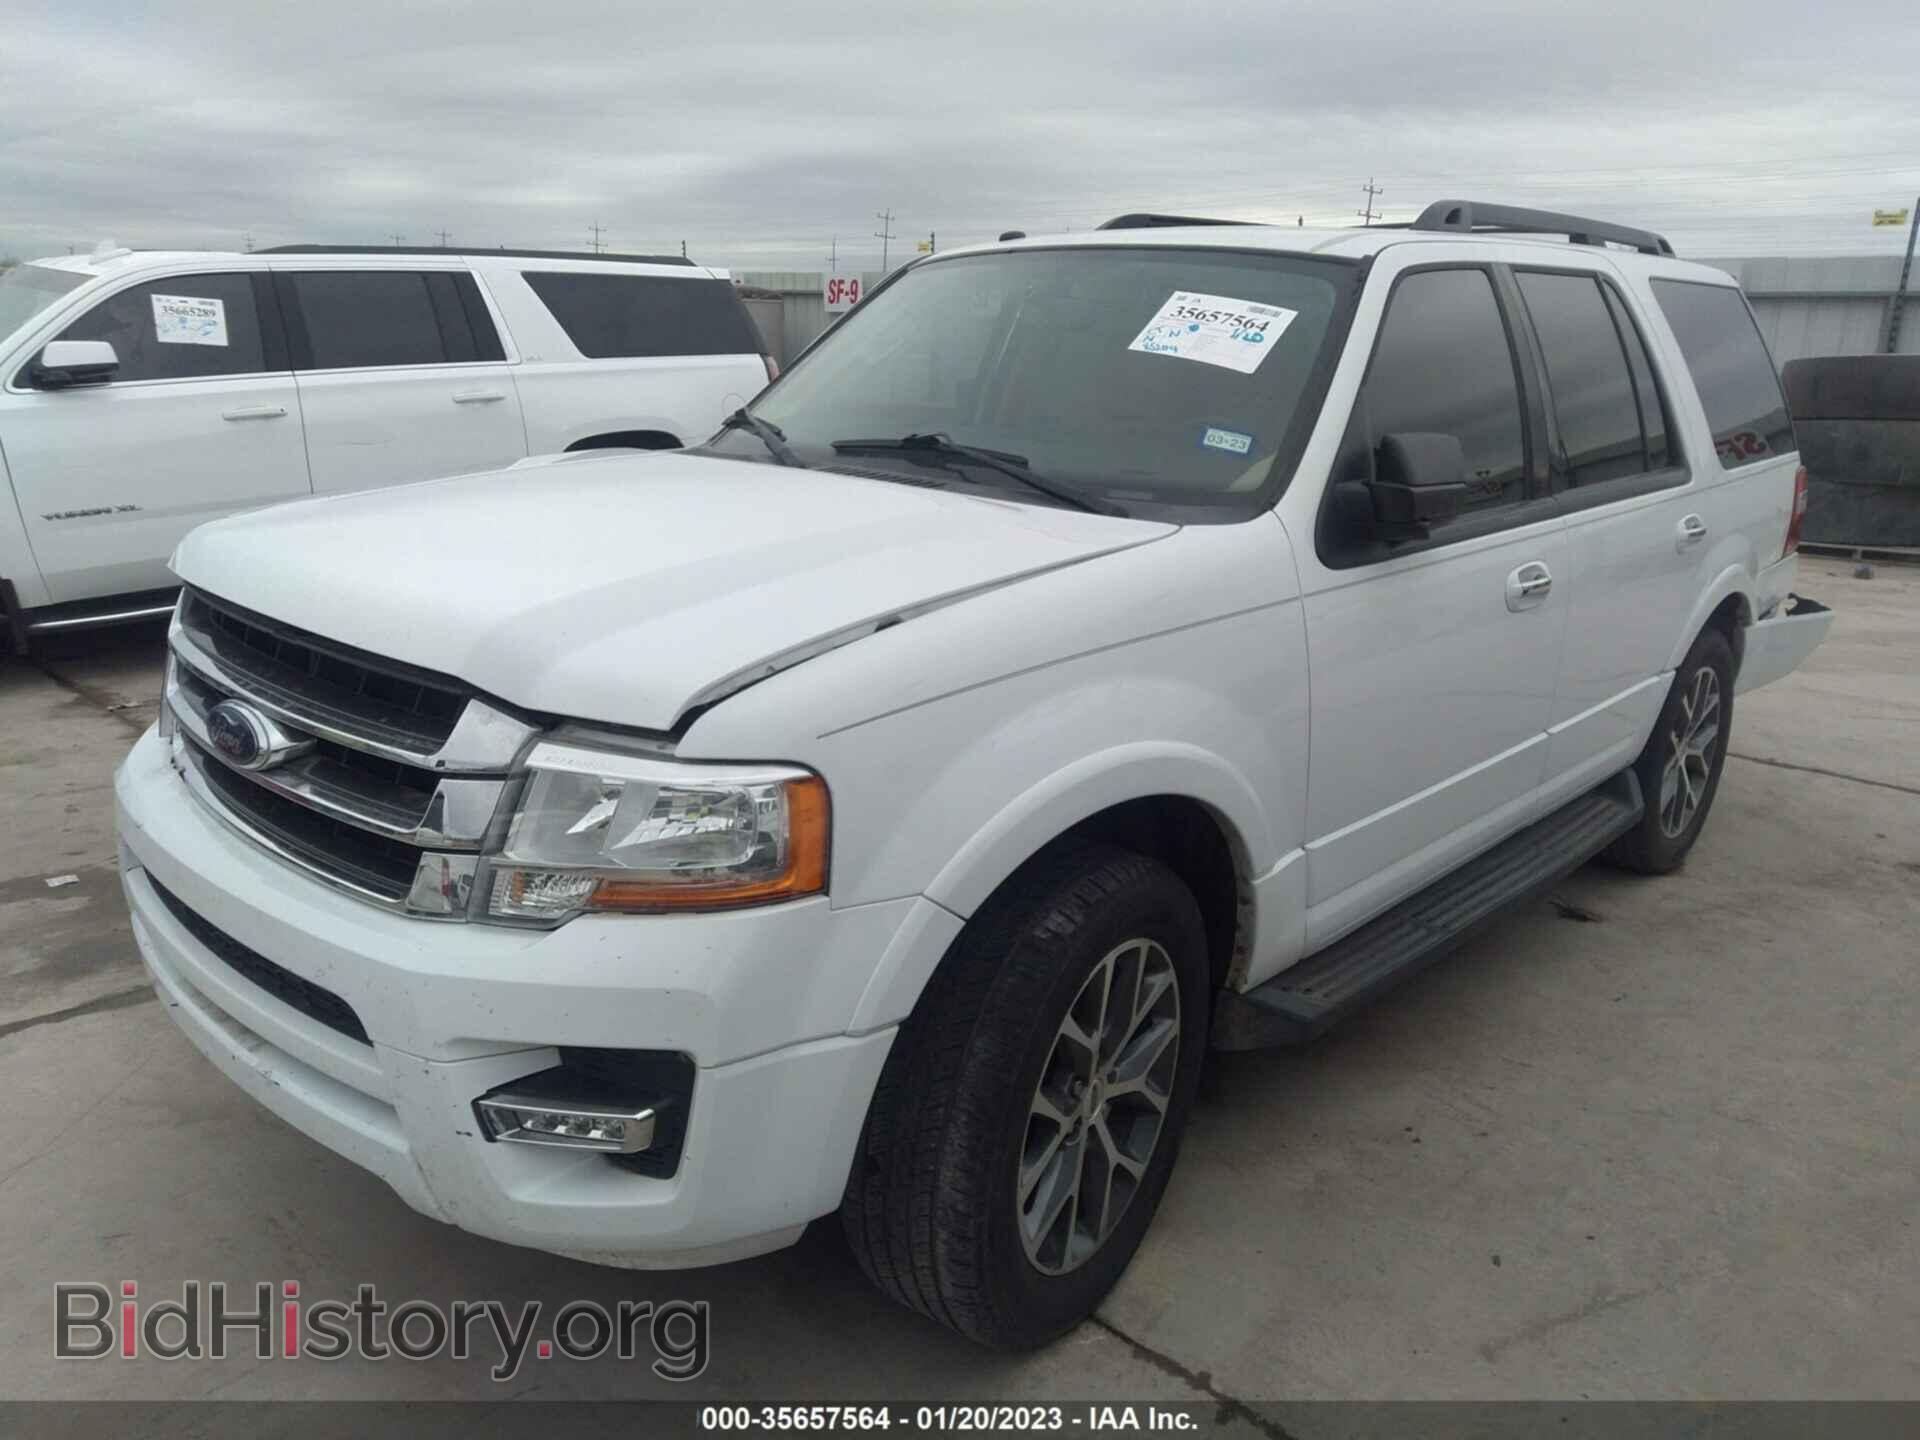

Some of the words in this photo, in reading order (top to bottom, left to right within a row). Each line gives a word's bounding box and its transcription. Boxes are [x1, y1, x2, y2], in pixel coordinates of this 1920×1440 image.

[827, 278, 858, 305] SF-9
[1168, 305, 1272, 333] 35657564
[1206, 433, 1248, 451] 03-23
